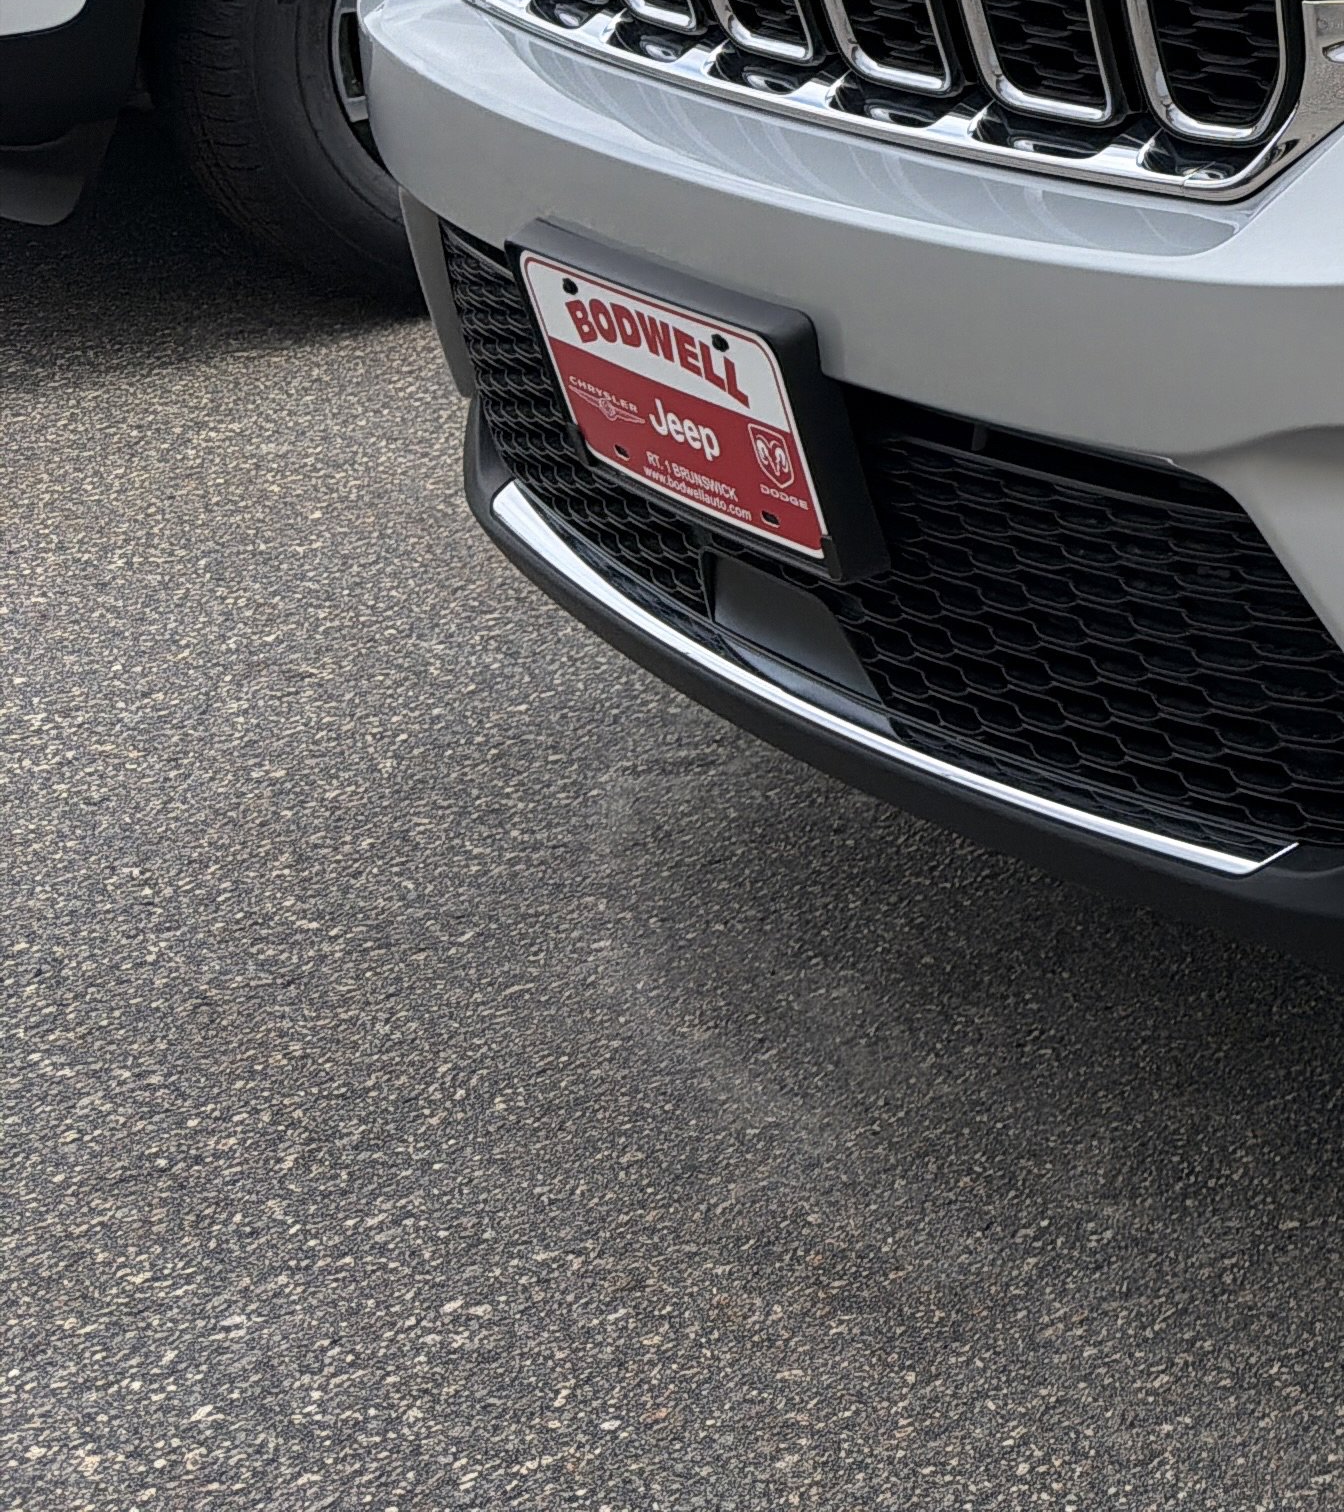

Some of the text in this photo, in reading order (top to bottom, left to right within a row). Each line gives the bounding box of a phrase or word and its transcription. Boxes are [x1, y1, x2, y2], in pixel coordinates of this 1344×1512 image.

[564, 298, 751, 410] BODWELL
[568, 375, 639, 414] CHRYSLER
[648, 397, 721, 462] Jeep
[643, 465, 753, 522] www.bodwellauto.com
[645, 450, 664, 469] RT.
[671, 462, 739, 503] BRUNSWICK
[759, 483, 809, 511] DODGE
